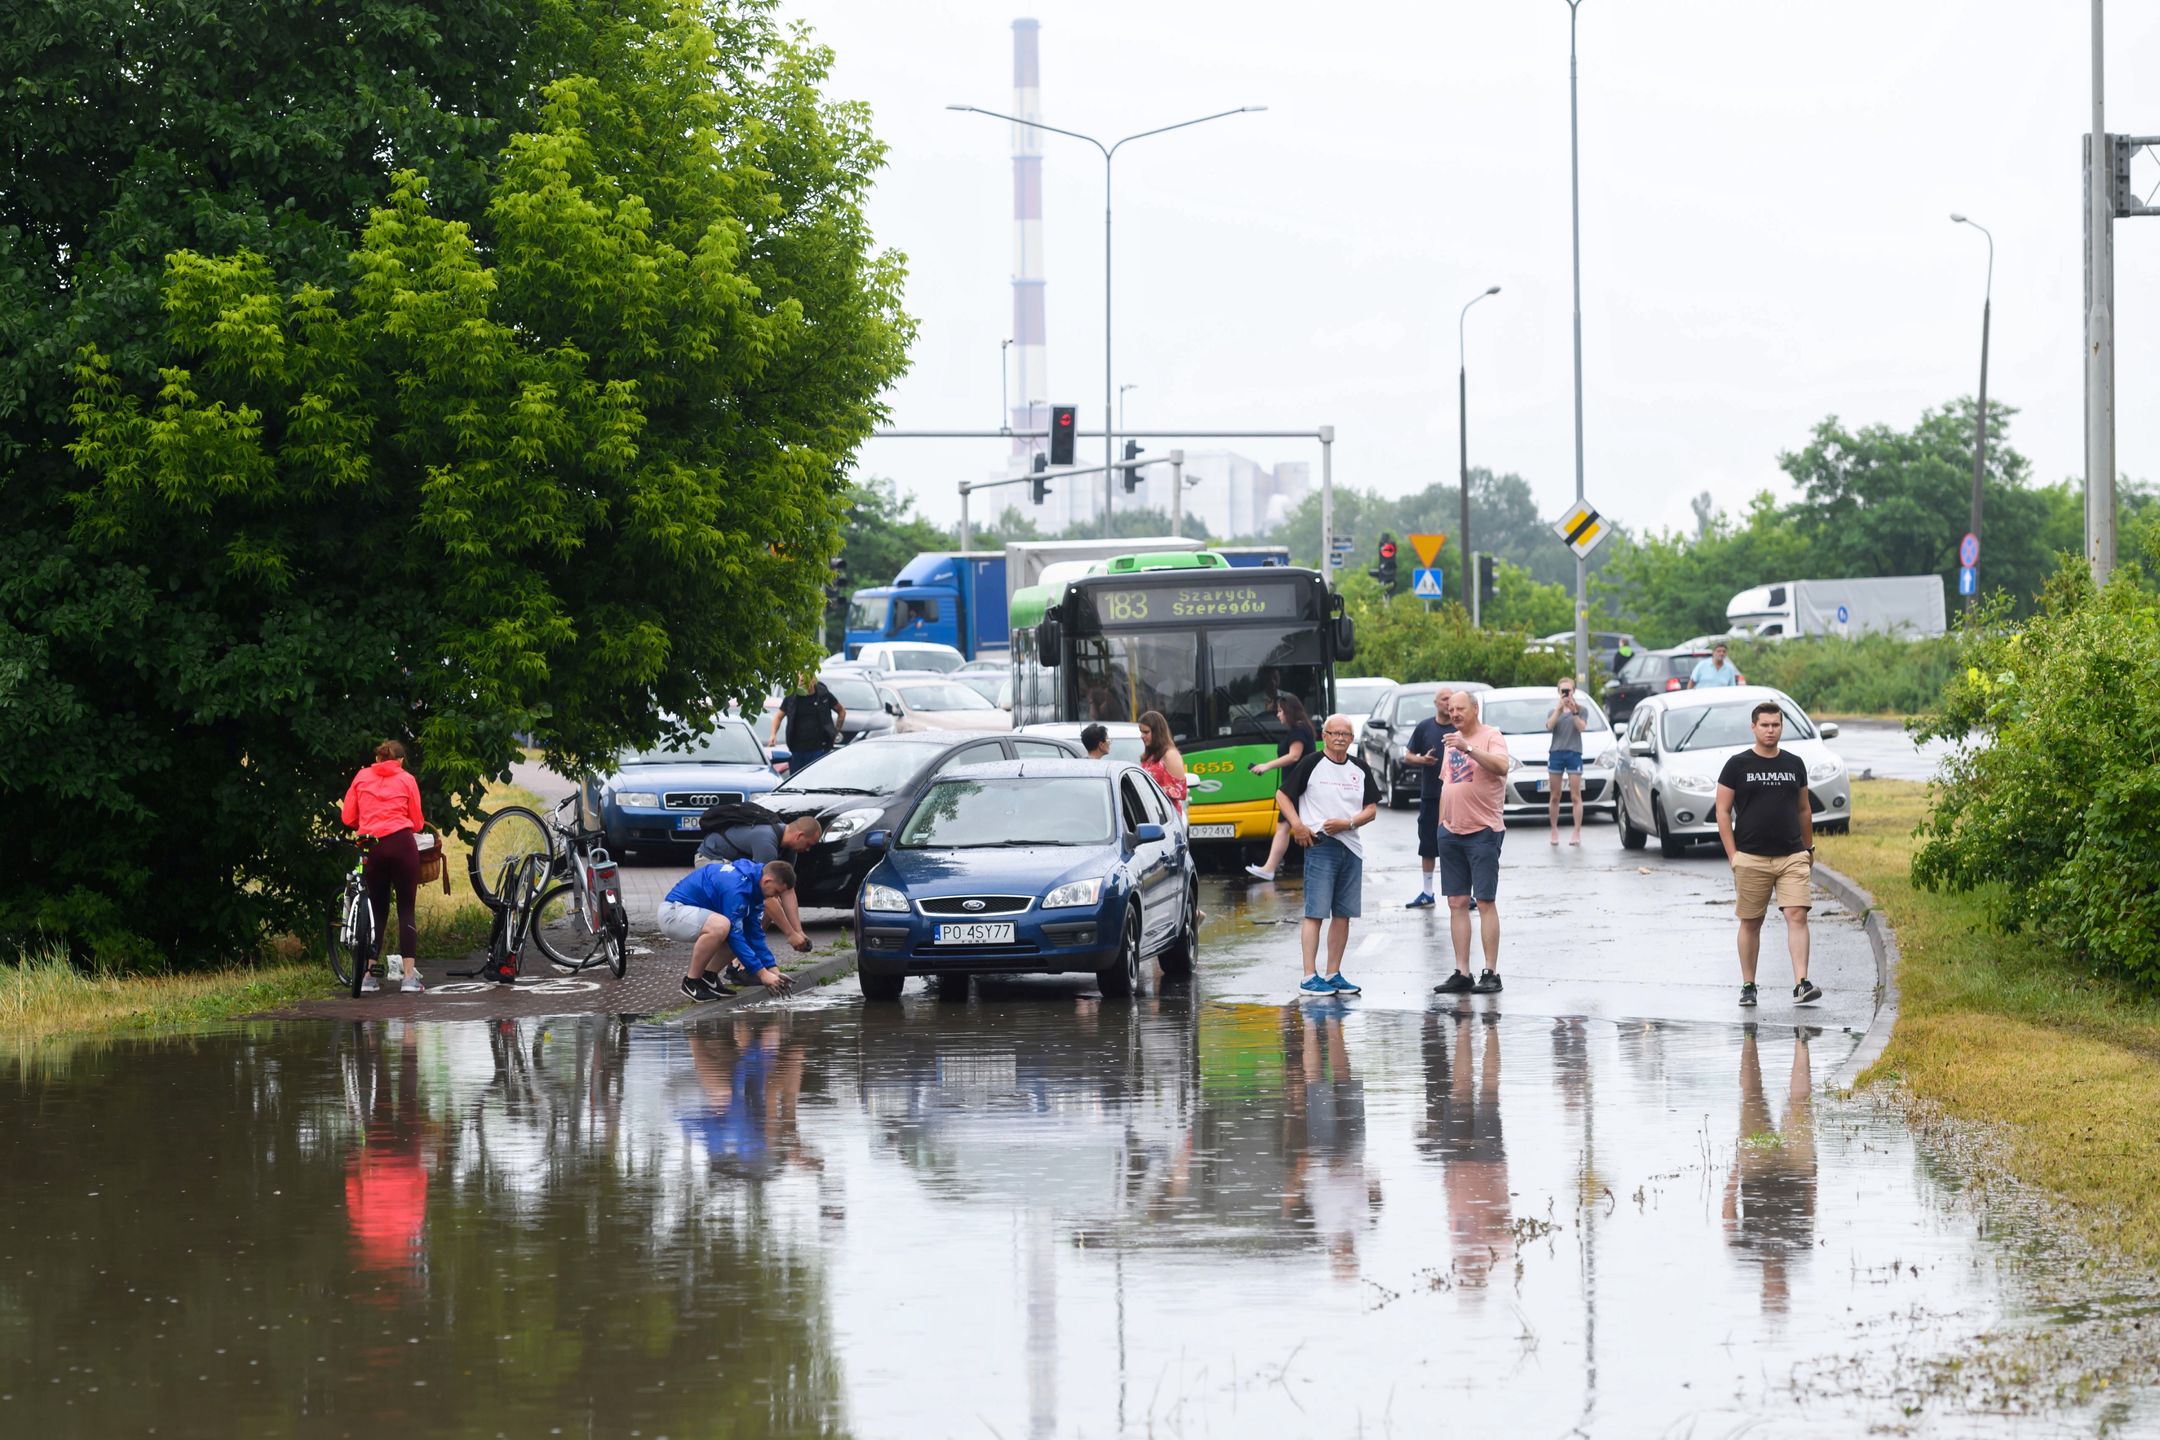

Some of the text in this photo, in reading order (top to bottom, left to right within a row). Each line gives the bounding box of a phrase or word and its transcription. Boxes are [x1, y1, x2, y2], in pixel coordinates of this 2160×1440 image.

[1179, 588, 1258, 602] Szarych
[1104, 591, 1148, 620] 183
[1172, 600, 1266, 616] Szeregów
[1746, 772, 1796, 782] BALMAIN
[967, 924, 1010, 939] 4SY77
